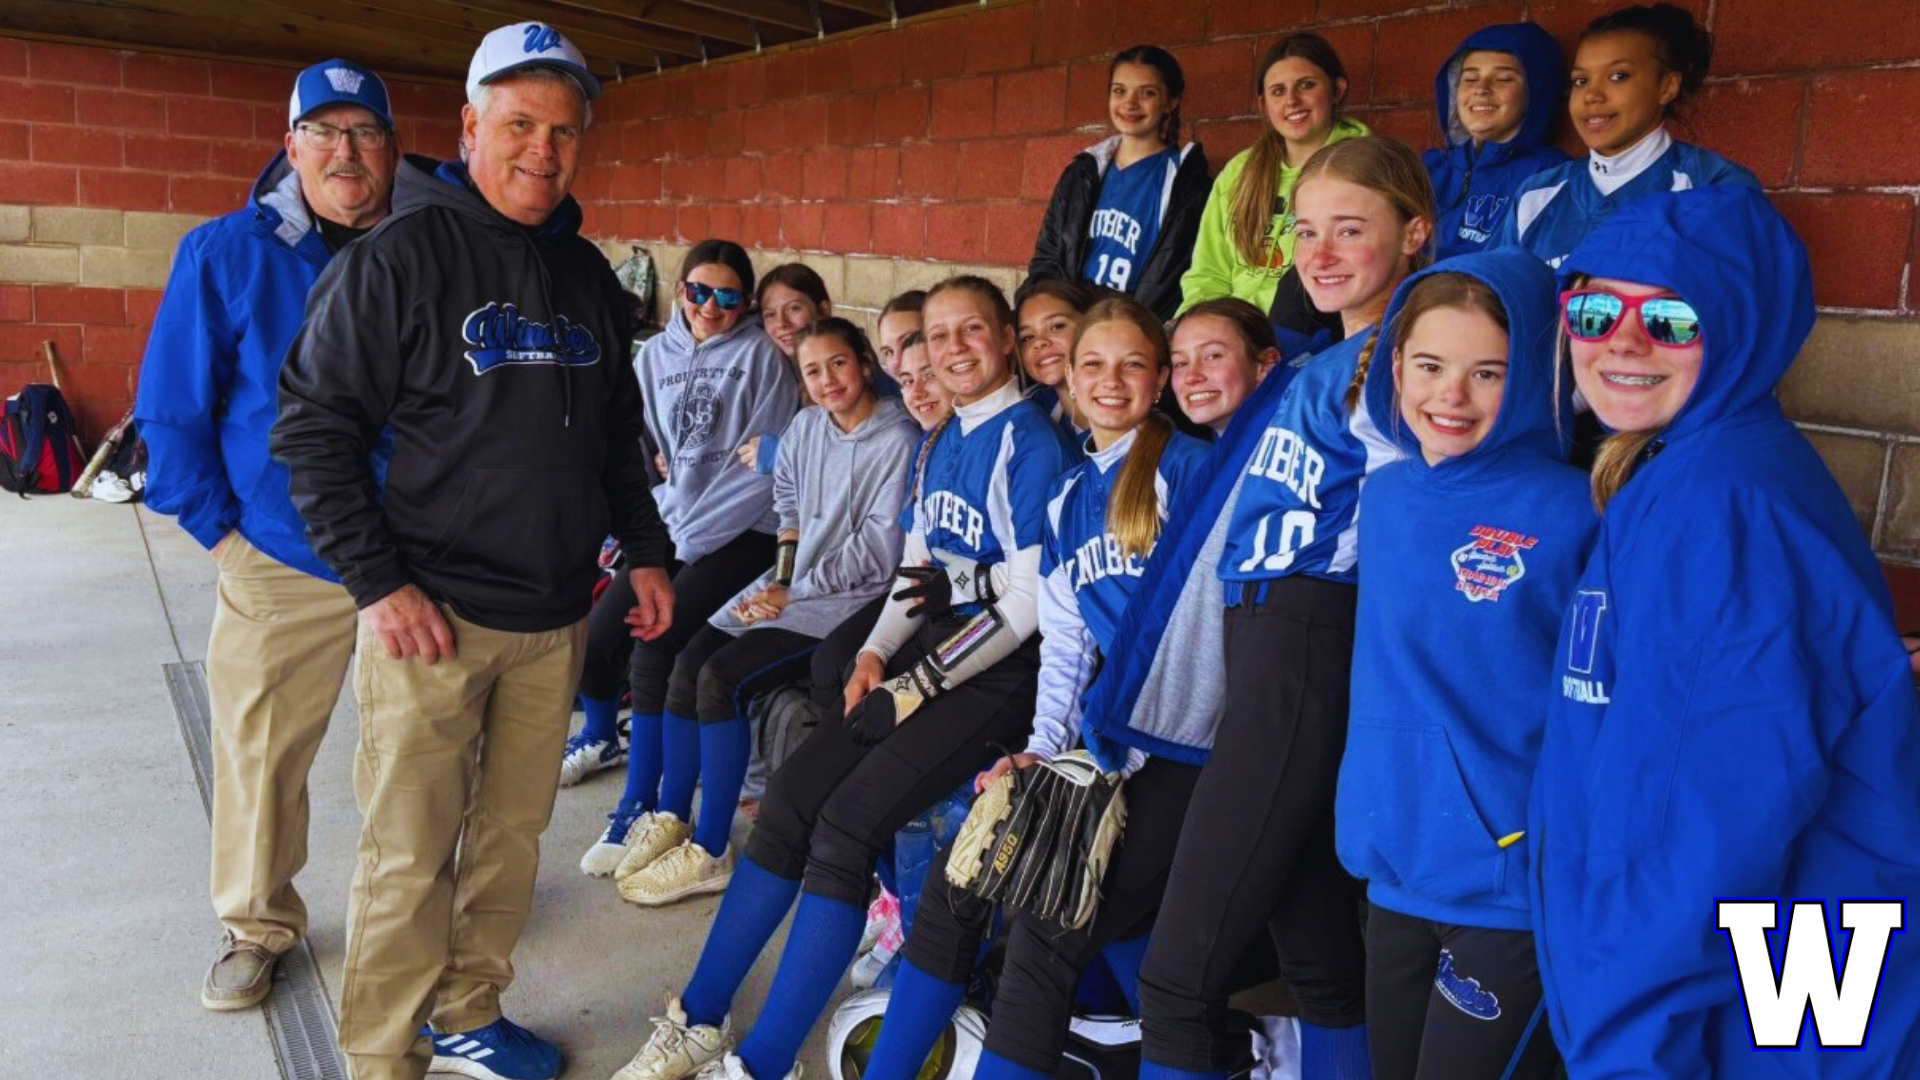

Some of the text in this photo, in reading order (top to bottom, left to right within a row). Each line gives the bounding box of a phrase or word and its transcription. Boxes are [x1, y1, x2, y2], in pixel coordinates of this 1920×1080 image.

[523, 23, 562, 53] W
[323, 66, 365, 95] W
[1464, 193, 1510, 233] W
[1094, 253, 1132, 293] 19
[1239, 510, 1317, 573] 10
[1468, 525, 1540, 550] DOUBLE
[1472, 538, 1519, 559] PLAY
